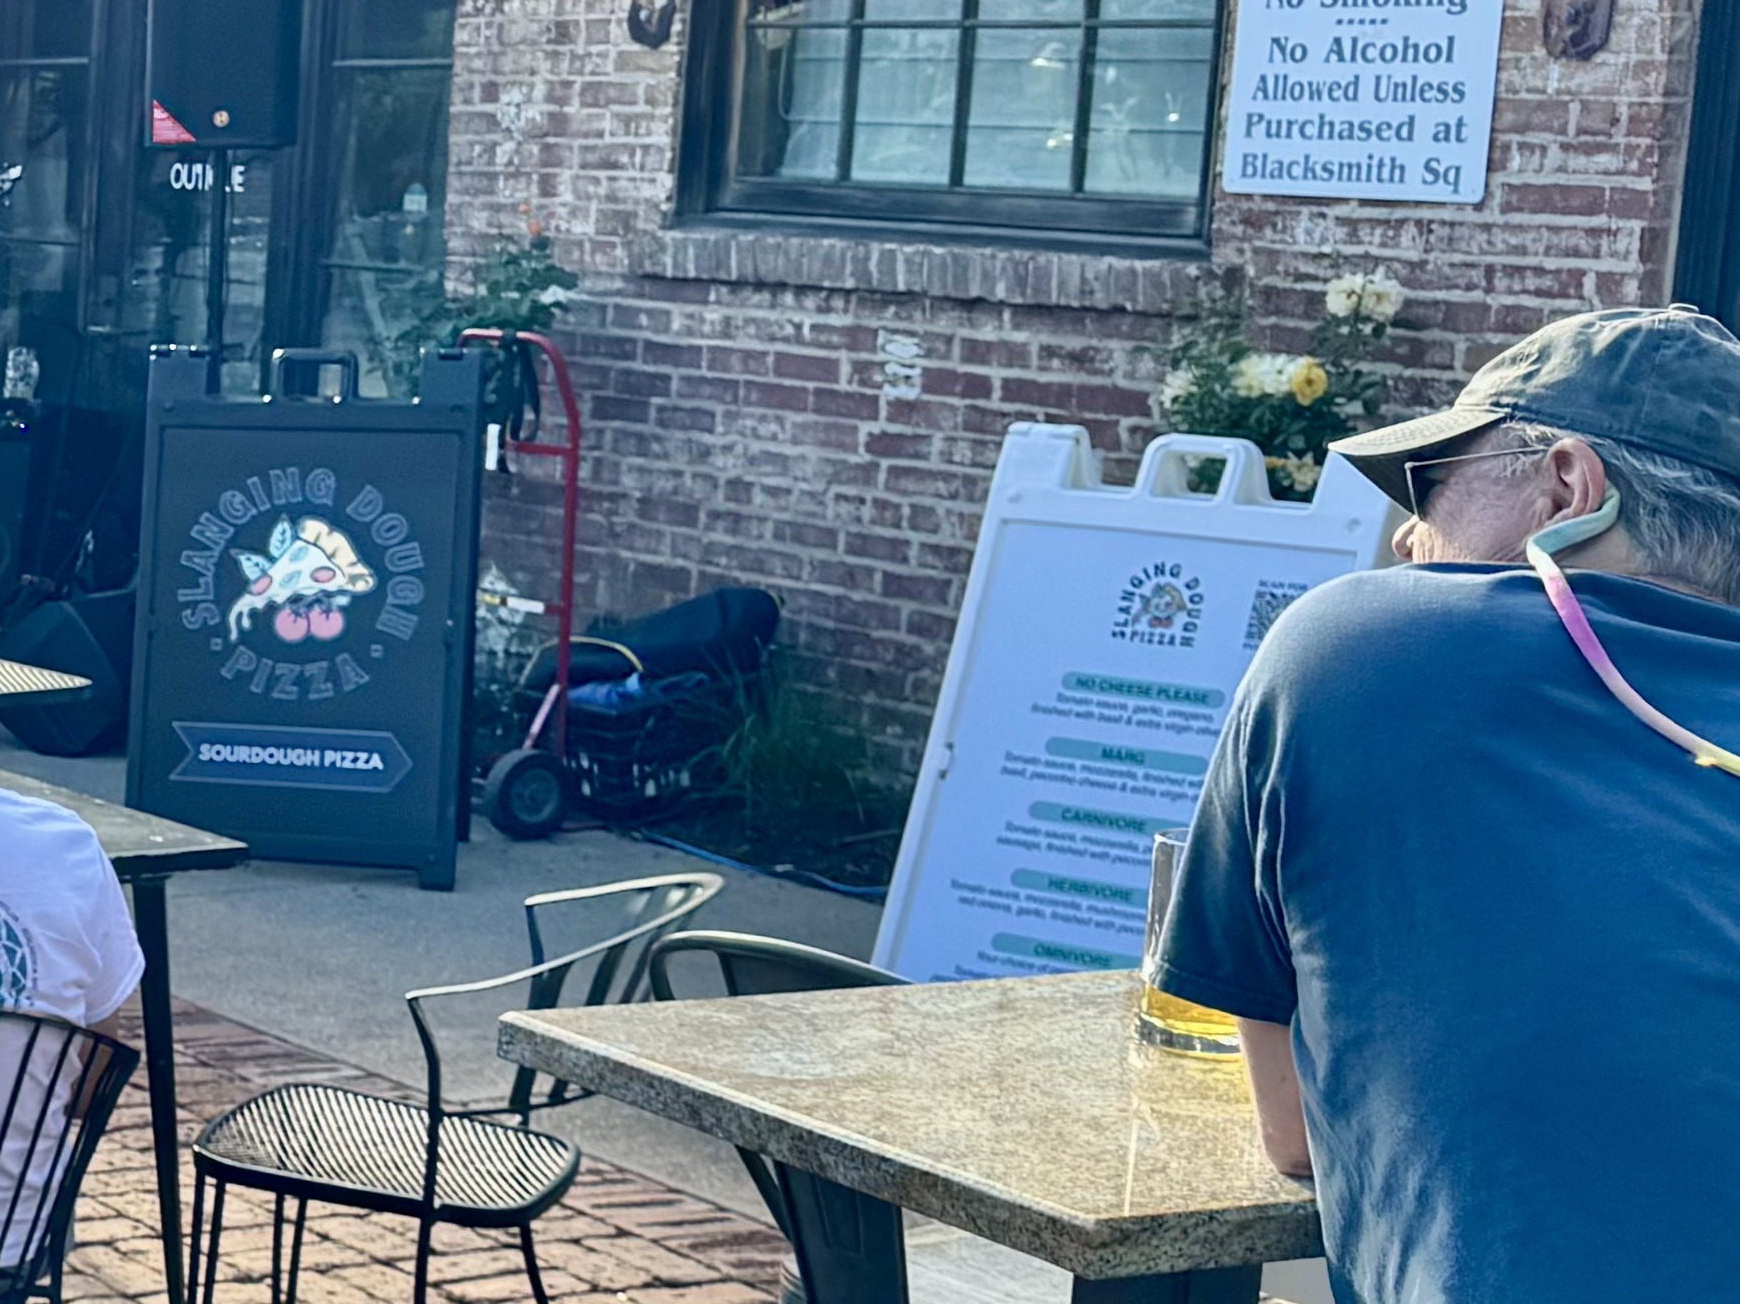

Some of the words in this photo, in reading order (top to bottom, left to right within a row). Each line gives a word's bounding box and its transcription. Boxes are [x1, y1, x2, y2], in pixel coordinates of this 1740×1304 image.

[1268, 36, 1309, 64] No
[1322, 35, 1456, 64] Alcohol
[1251, 73, 1360, 104] Allowed
[1373, 74, 1467, 104] Unless
[1243, 112, 1416, 143] Purchased
[1431, 115, 1469, 144] at
[1239, 153, 1407, 185] Blacksmith
[1421, 157, 1463, 195] Sq
[177, 467, 336, 630] SLANGING
[345, 484, 424, 642] DOUGH
[1110, 560, 1183, 640] SLANGING
[1179, 576, 1205, 648] DOUGH
[1129, 630, 1177, 647] PIZZA
[220, 645, 371, 701] PIZZA
[198, 742, 322, 768] SOURDOUGH
[323, 750, 384, 771] PIZZA
[1061, 807, 1147, 833] CARNIVORE
